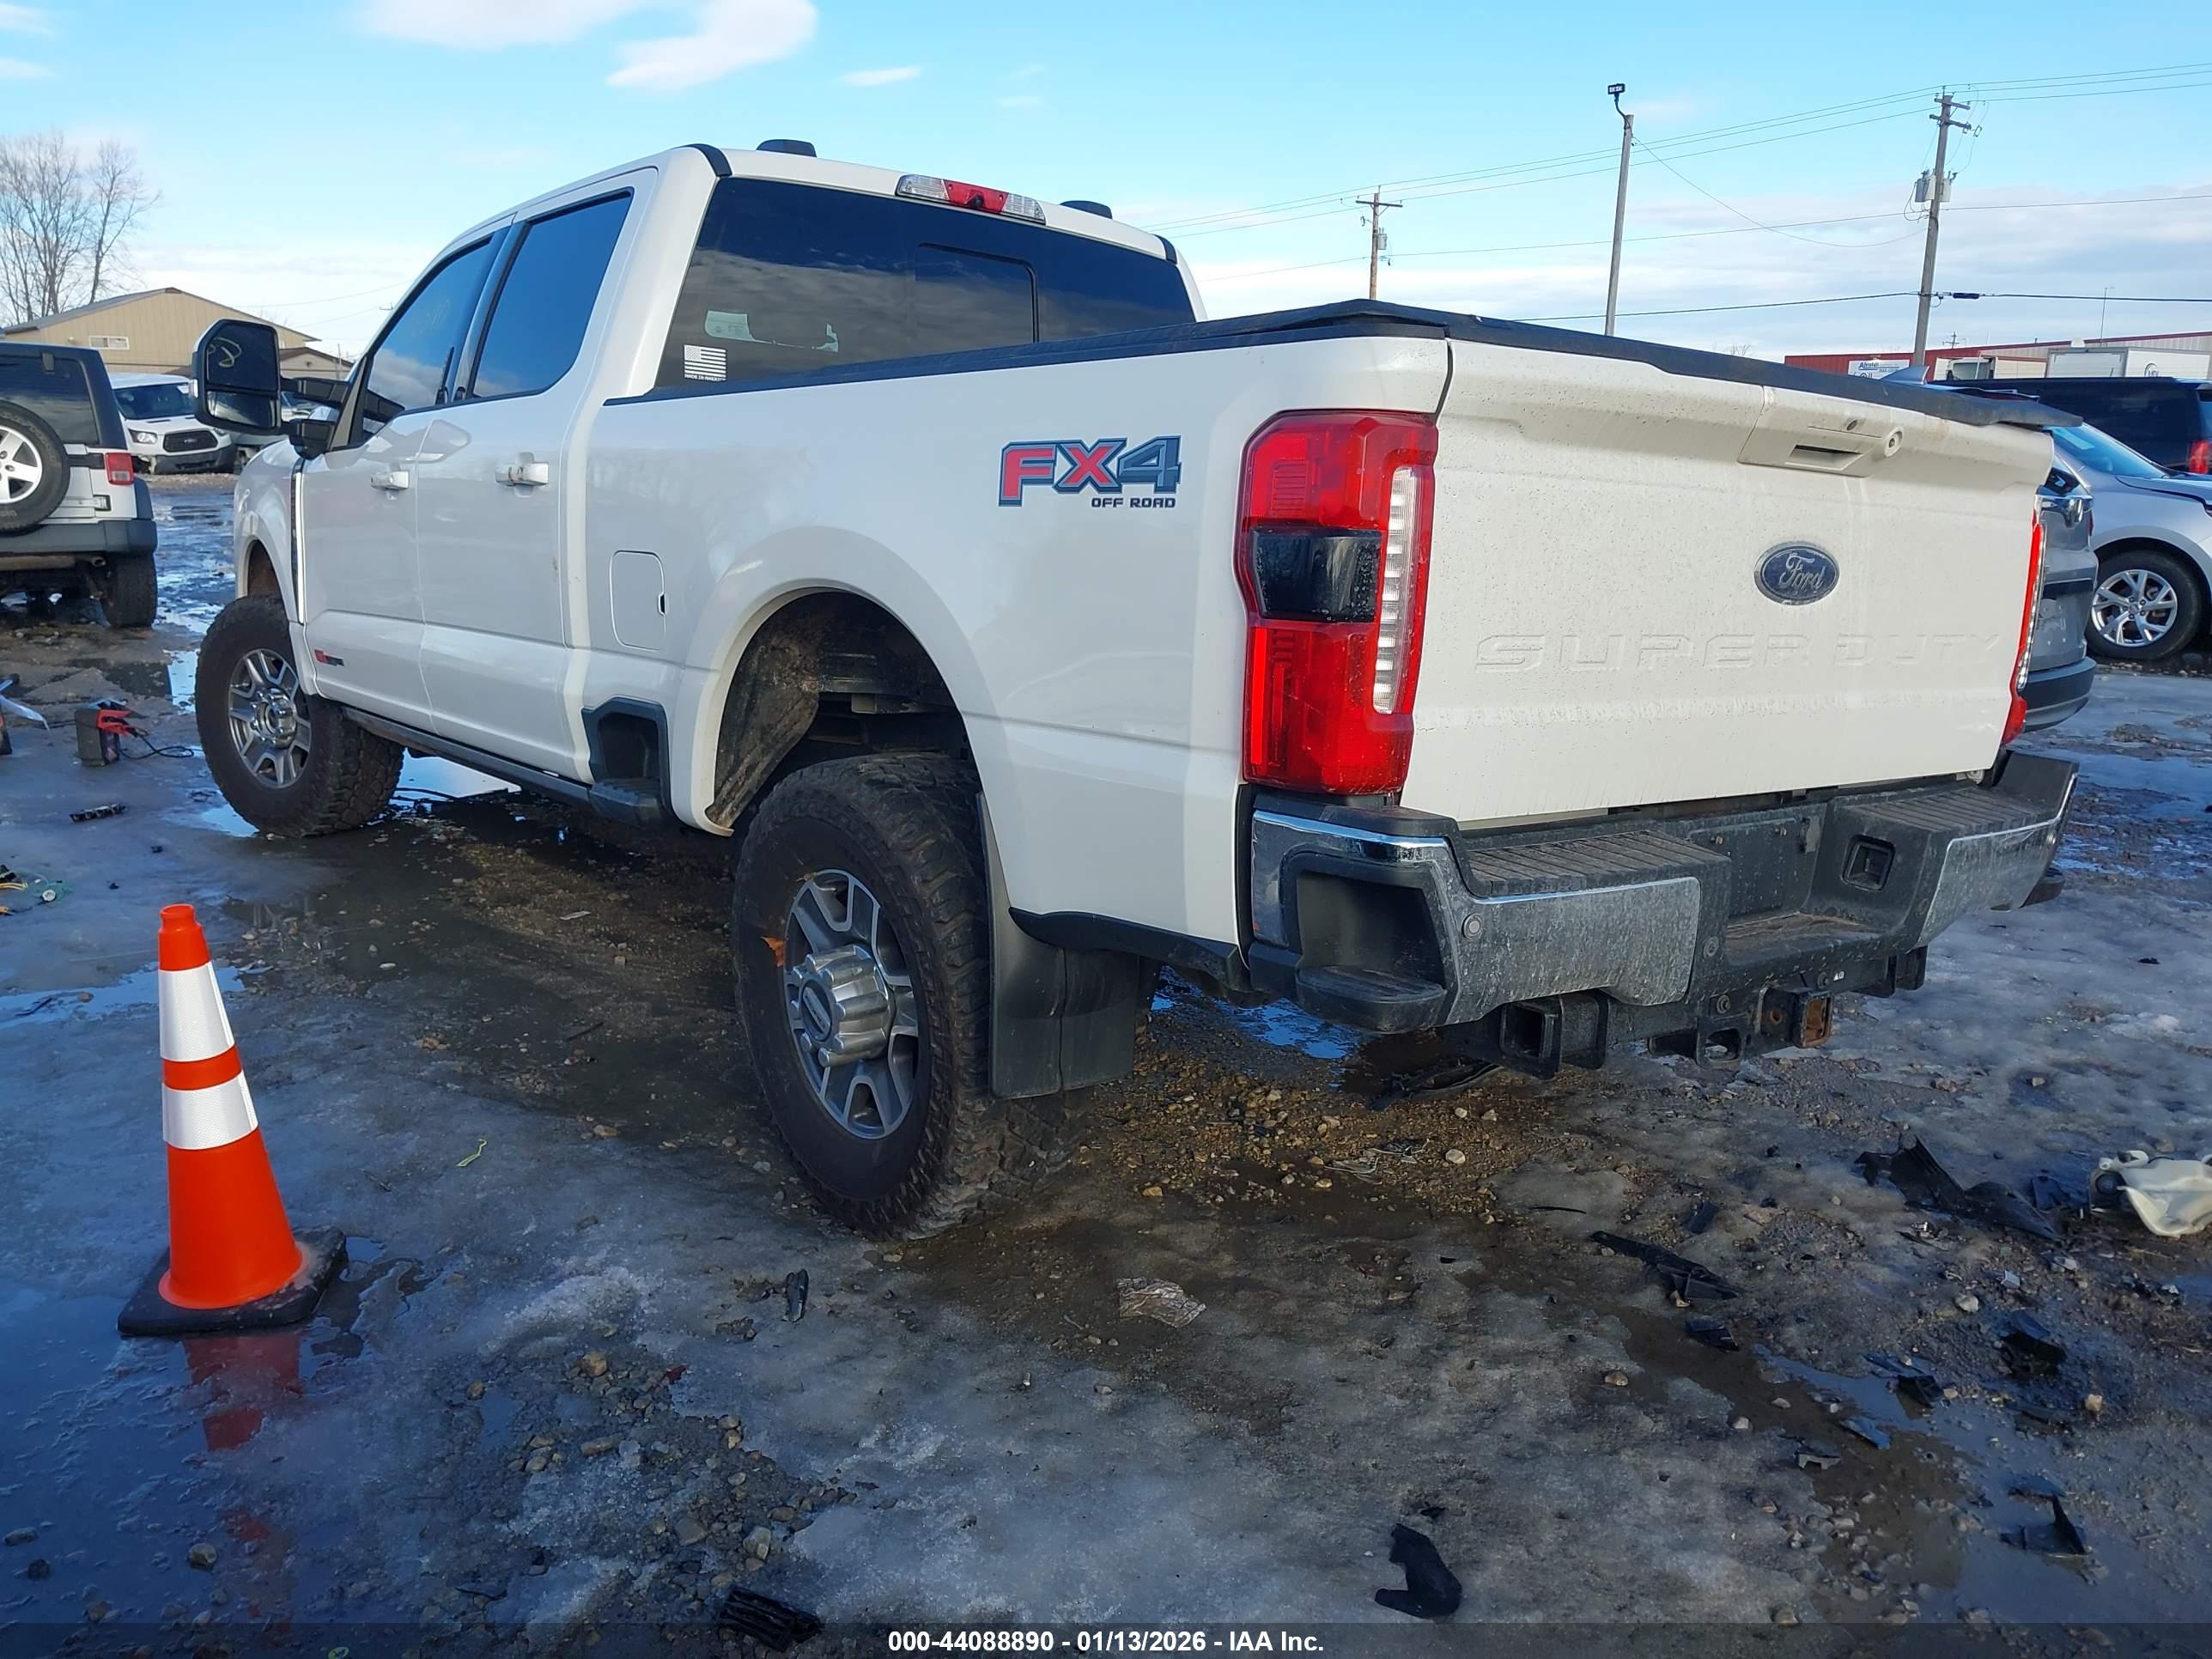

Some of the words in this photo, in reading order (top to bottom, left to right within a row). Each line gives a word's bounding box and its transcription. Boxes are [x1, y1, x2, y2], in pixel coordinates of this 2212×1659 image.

[999, 435, 1182, 507] FX4
[1091, 497, 1123, 508] OFF
[1129, 497, 1176, 508] ROAD
[1778, 551, 1826, 592] Ford
[1475, 634, 1813, 673] SUPER
[1833, 634, 2000, 666] DUTY
